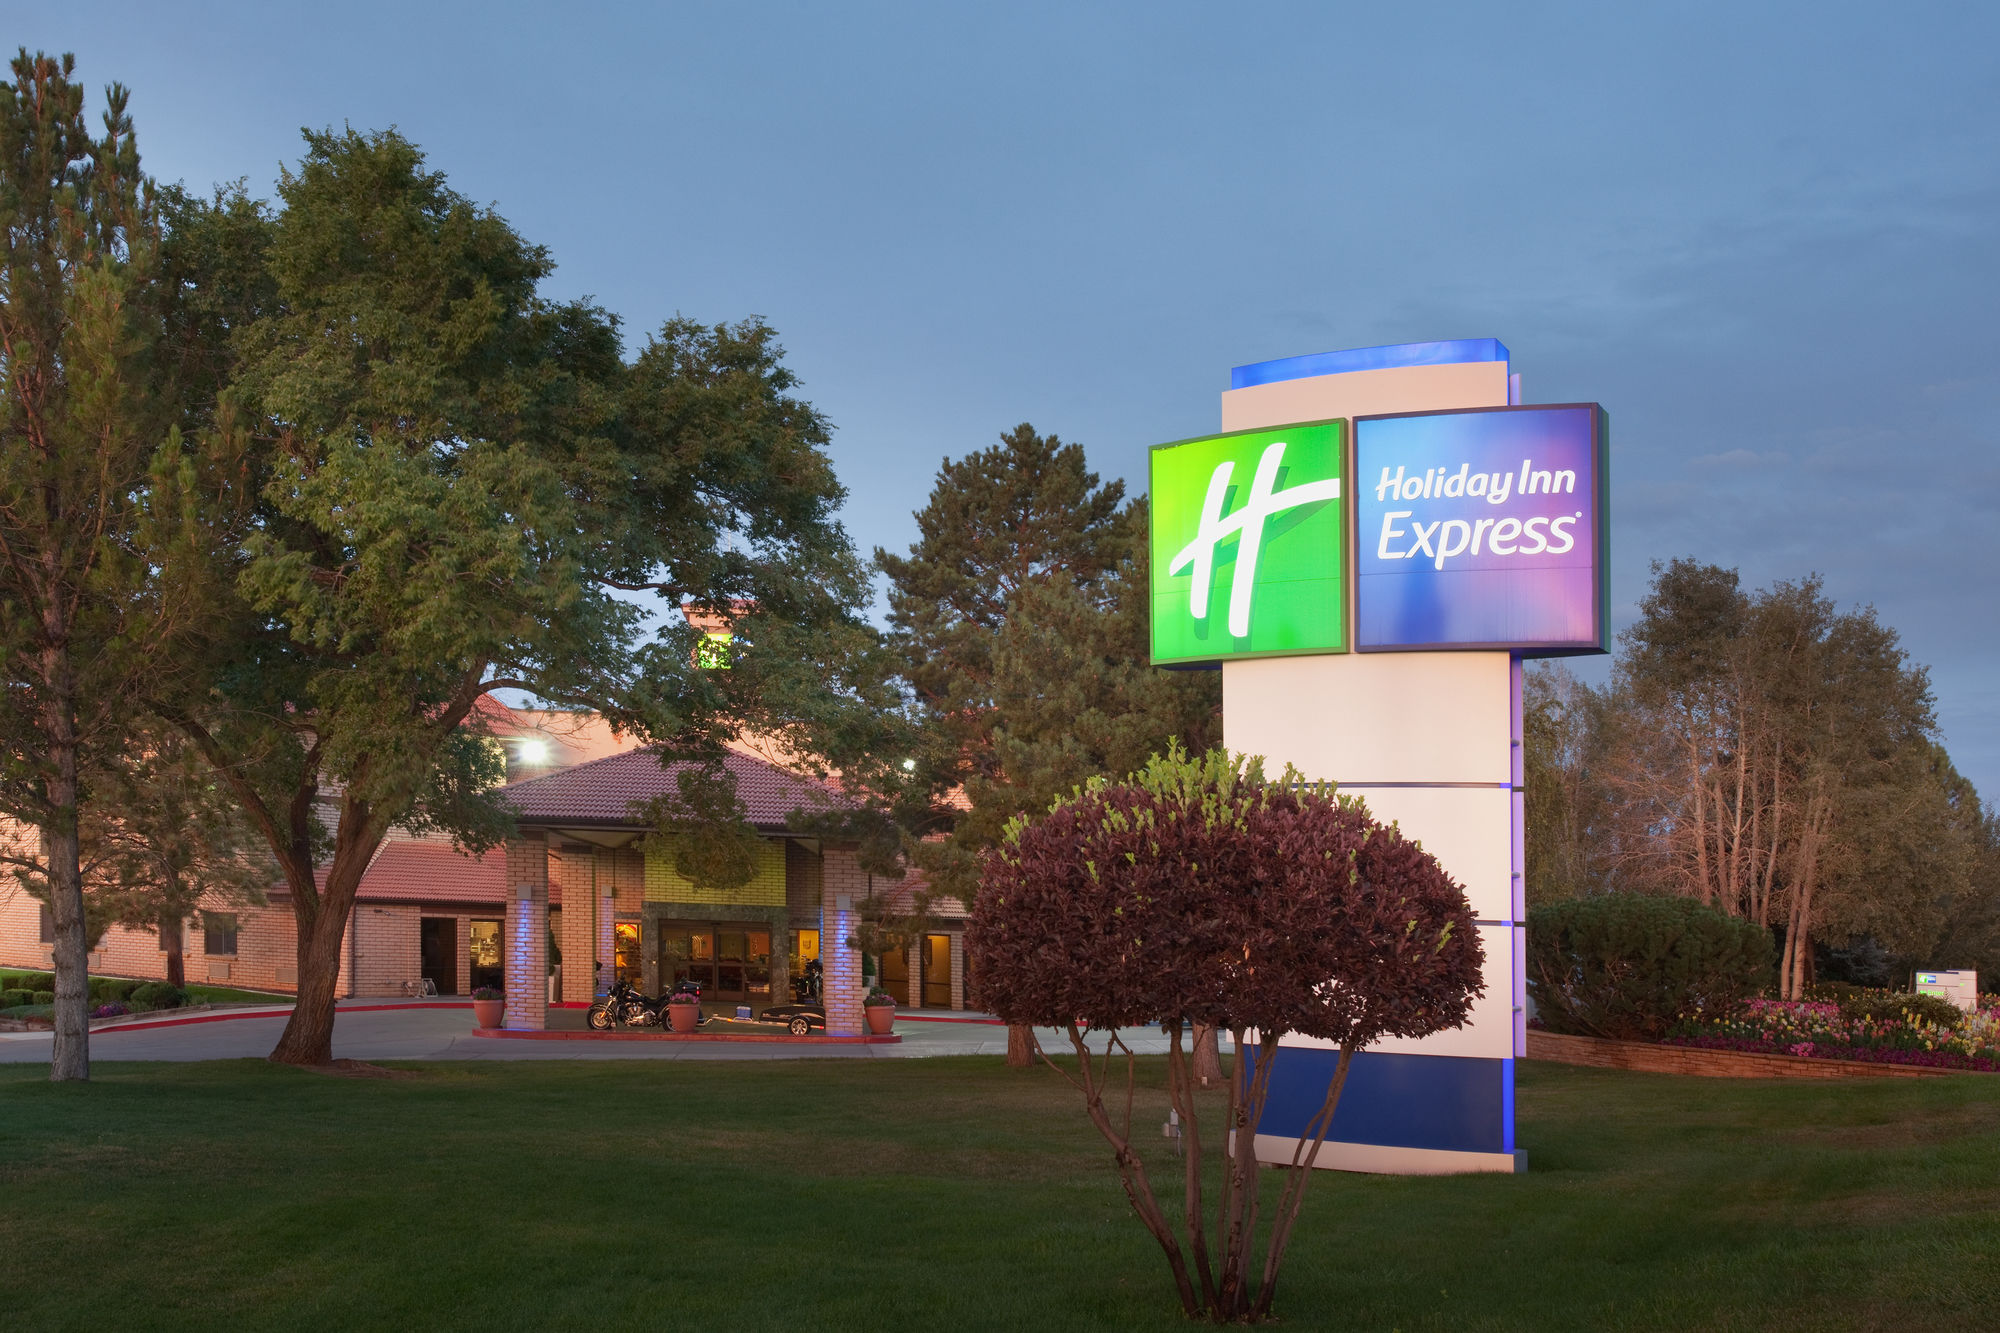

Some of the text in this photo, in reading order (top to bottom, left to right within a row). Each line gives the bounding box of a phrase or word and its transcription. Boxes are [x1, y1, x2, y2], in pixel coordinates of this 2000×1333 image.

[1375, 459, 1576, 504] Holiday Inn
[1169, 442, 1340, 637] H
[1377, 510, 1576, 571] Express
